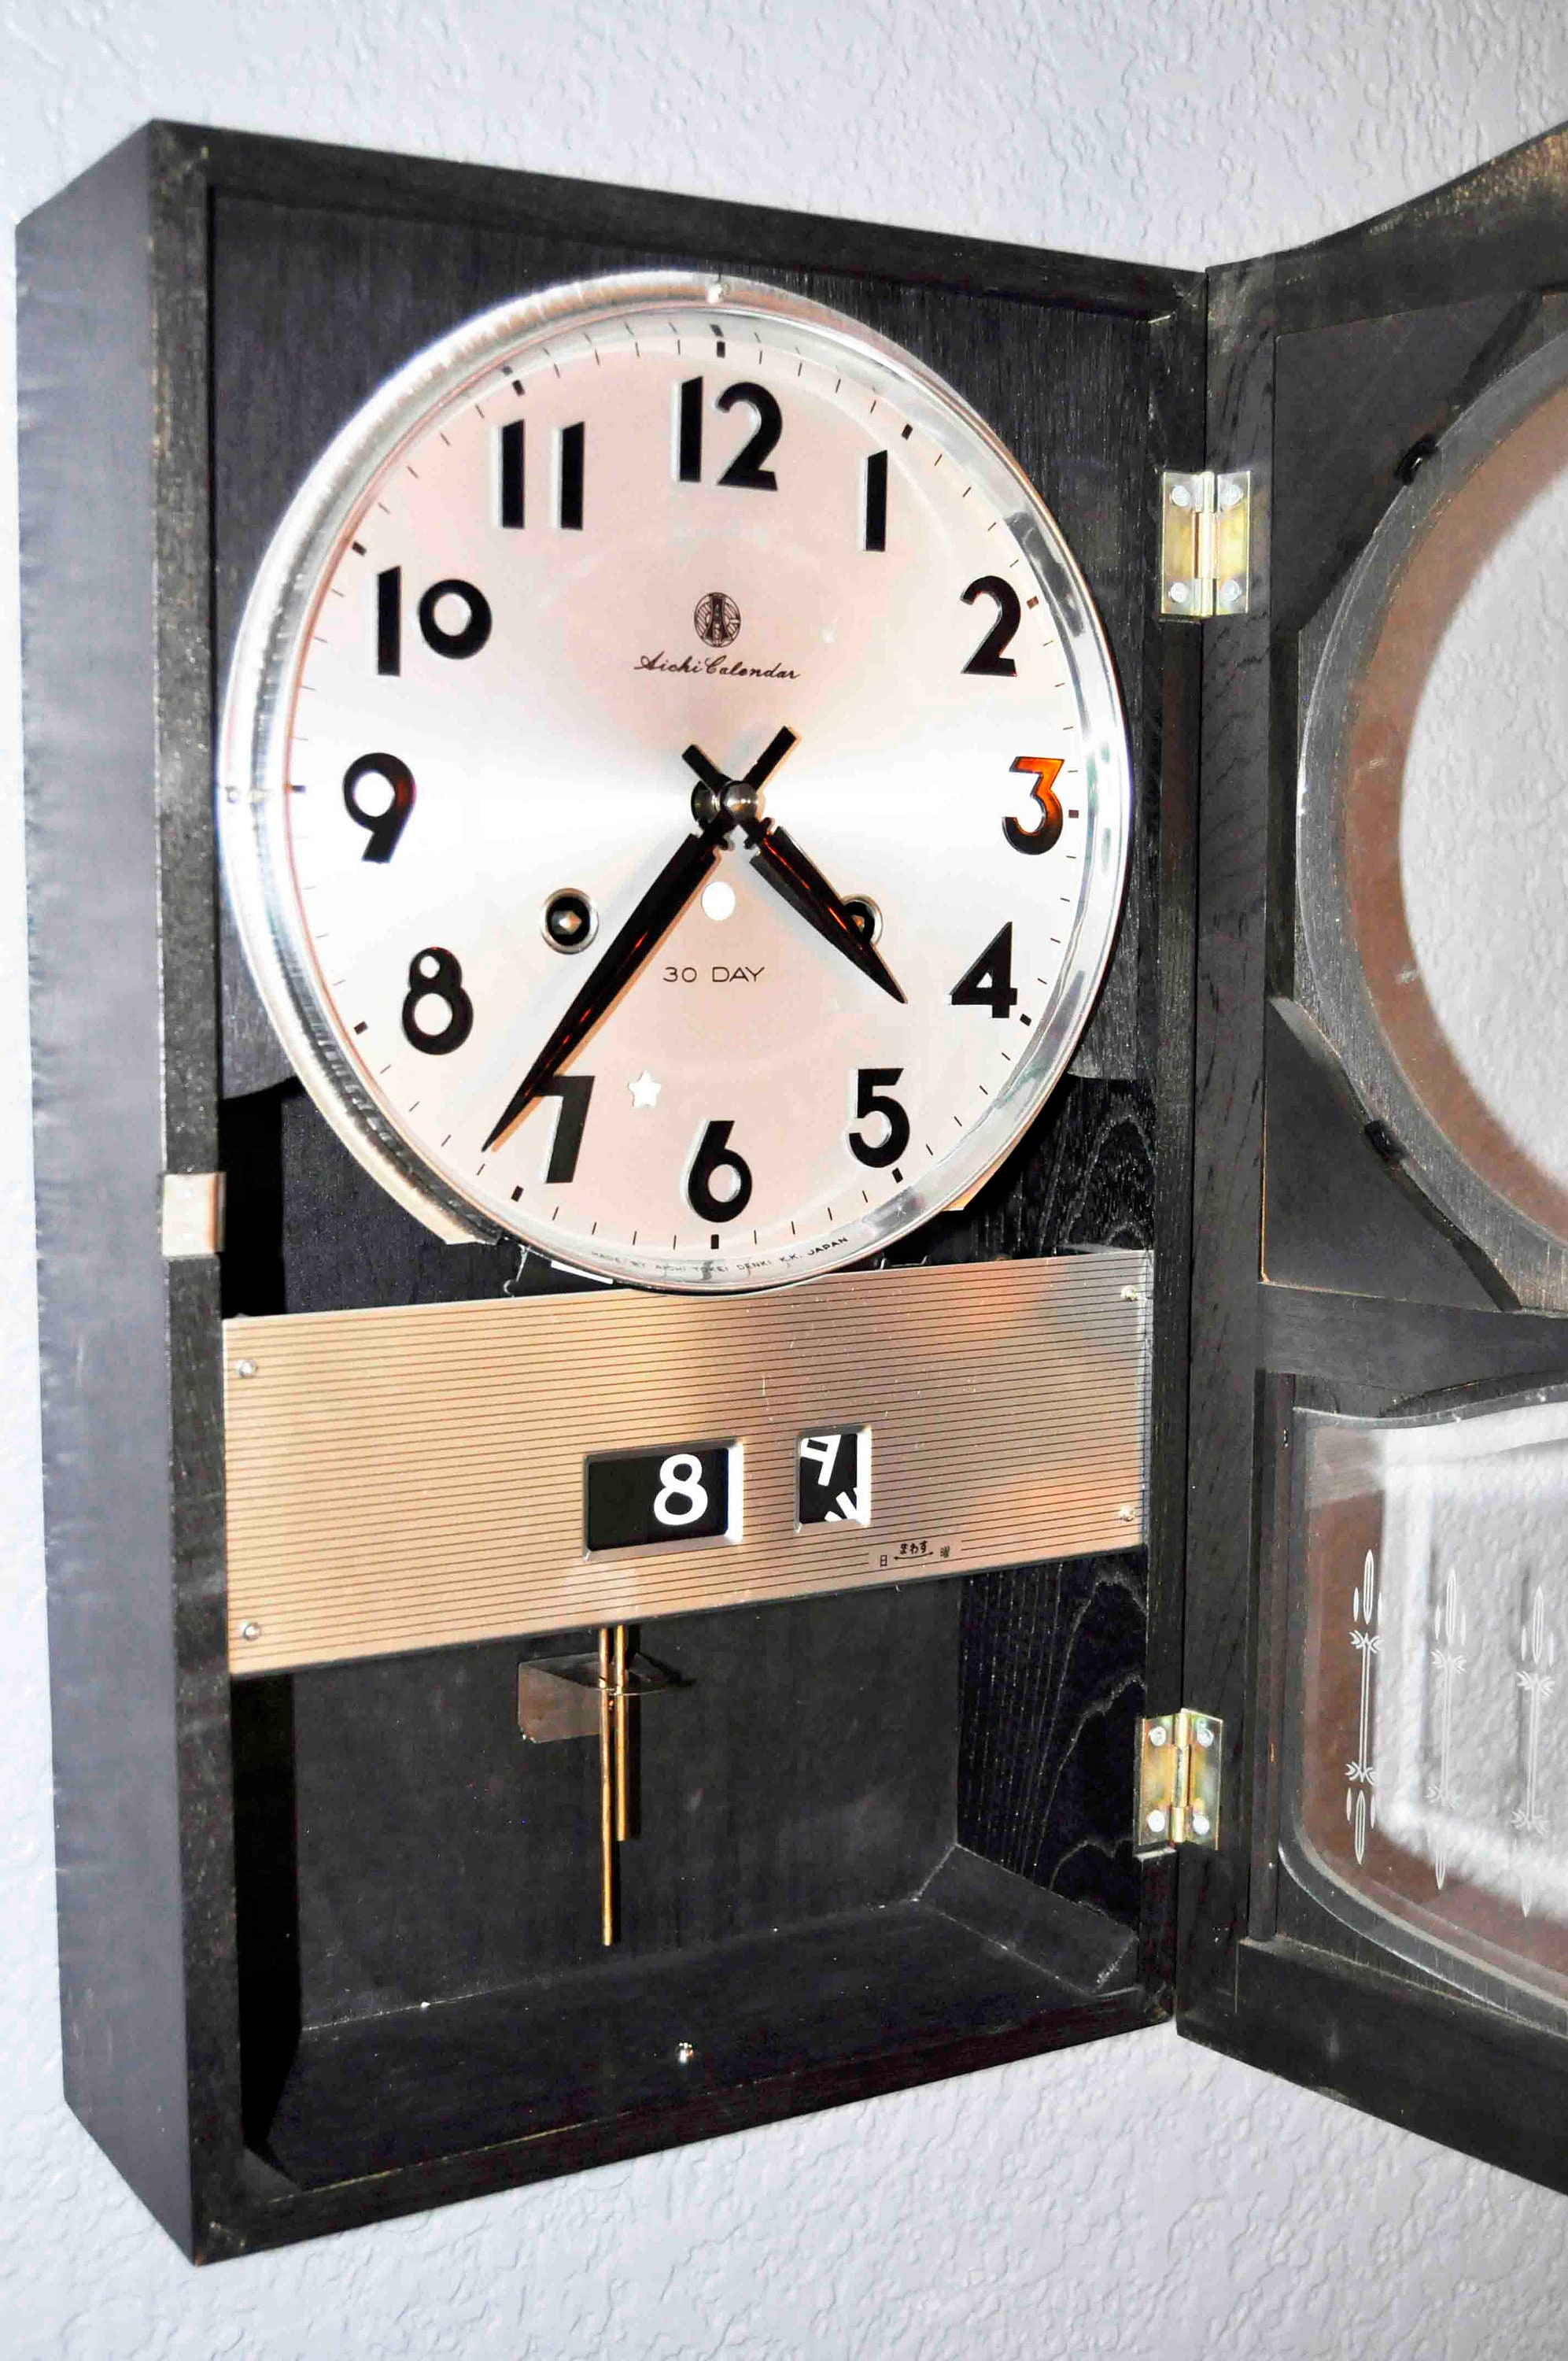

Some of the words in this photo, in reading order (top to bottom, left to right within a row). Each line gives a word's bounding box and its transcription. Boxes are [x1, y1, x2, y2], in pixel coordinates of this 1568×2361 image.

[502, 419, 585, 530] 11
[680, 376, 784, 491] 12
[865, 449, 888, 552] 1
[378, 566, 493, 675] 10
[634, 651, 700, 674] Aichi
[705, 655, 801, 679] Calendar
[961, 575, 1021, 678] 2
[343, 752, 415, 863] 9
[1002, 756, 1065, 855] 3
[402, 947, 474, 1055] 8
[663, 966, 697, 983] 30
[712, 966, 765, 983] DAY
[950, 922, 1017, 1018] 4
[532, 1075, 596, 1184] 7
[848, 1068, 910, 1168] 5
[688, 1120, 753, 1223] 6
[736, 1260, 772, 1271] DENKI
[807, 1236, 848, 1256] JAPAN
[653, 1453, 709, 1526] 8
[899, 1540, 928, 1554] まわす
